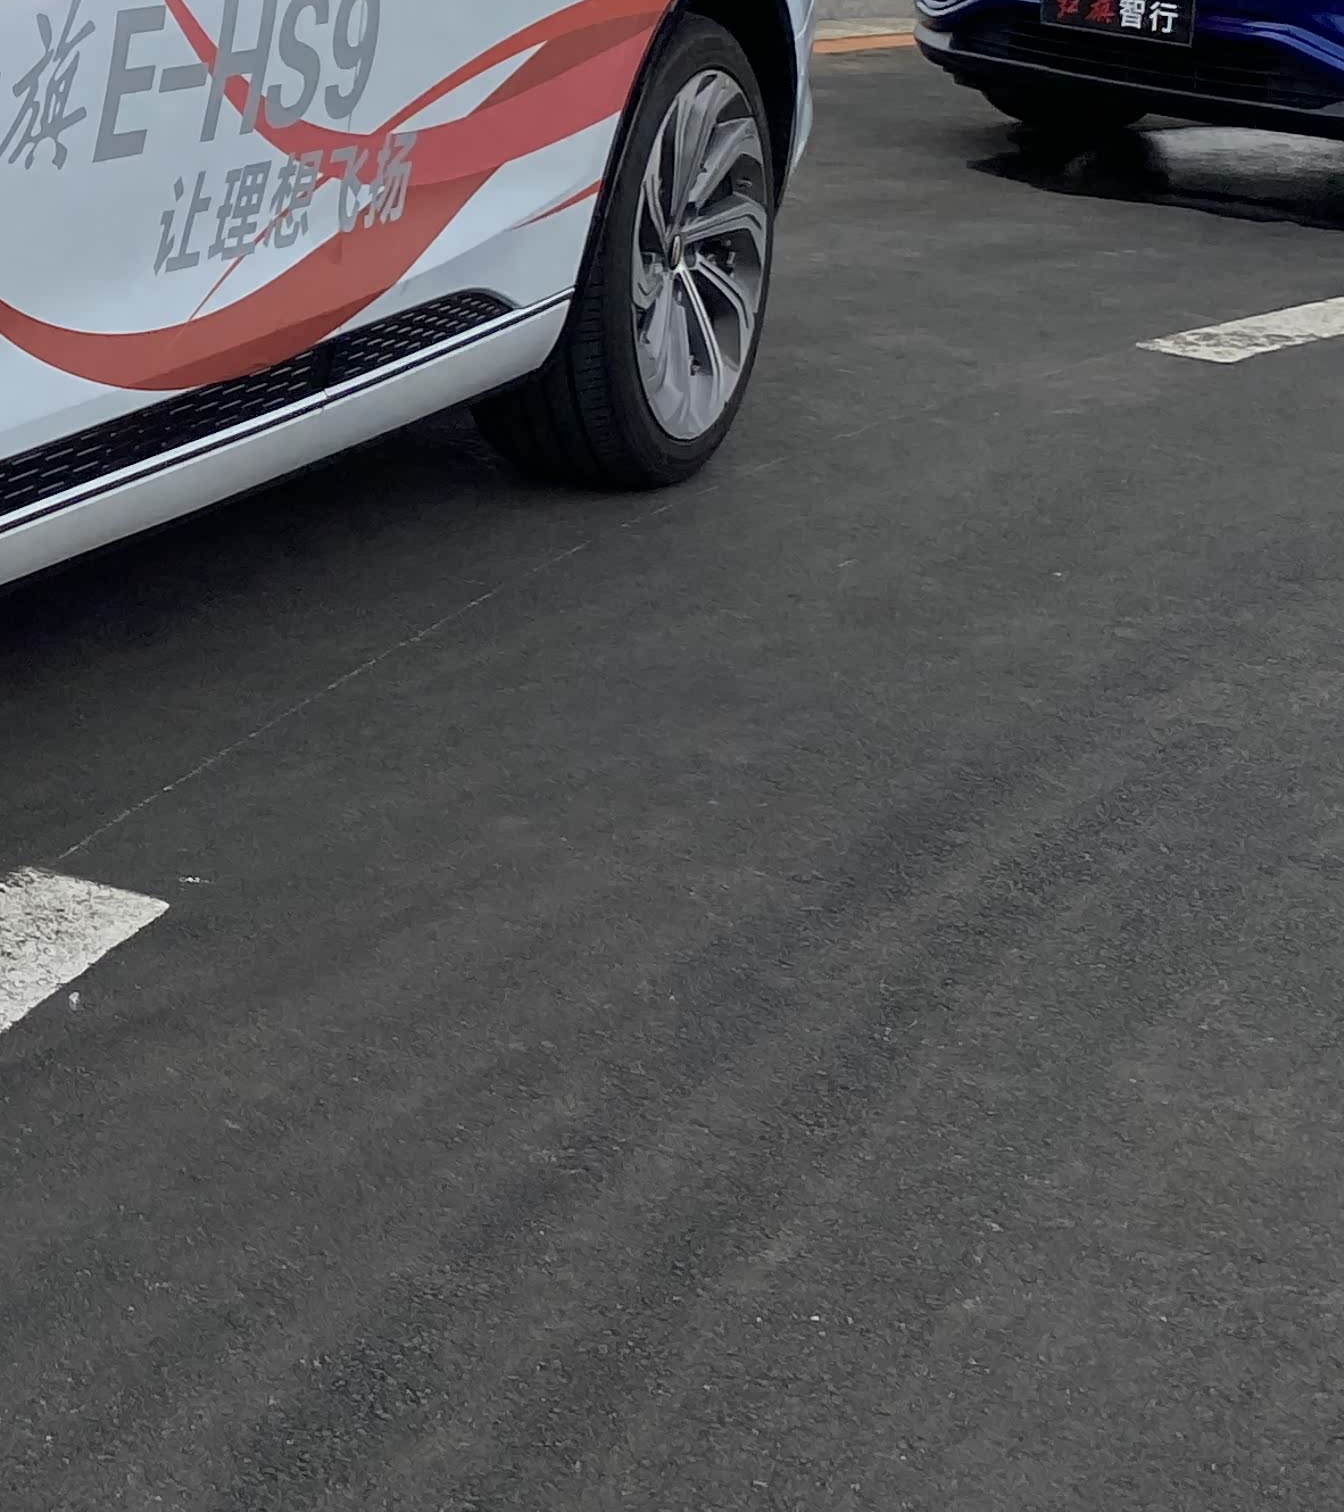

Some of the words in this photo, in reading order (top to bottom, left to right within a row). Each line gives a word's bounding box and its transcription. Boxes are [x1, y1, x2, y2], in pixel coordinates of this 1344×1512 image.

[154, 132, 418, 277] 让理想飞扬
